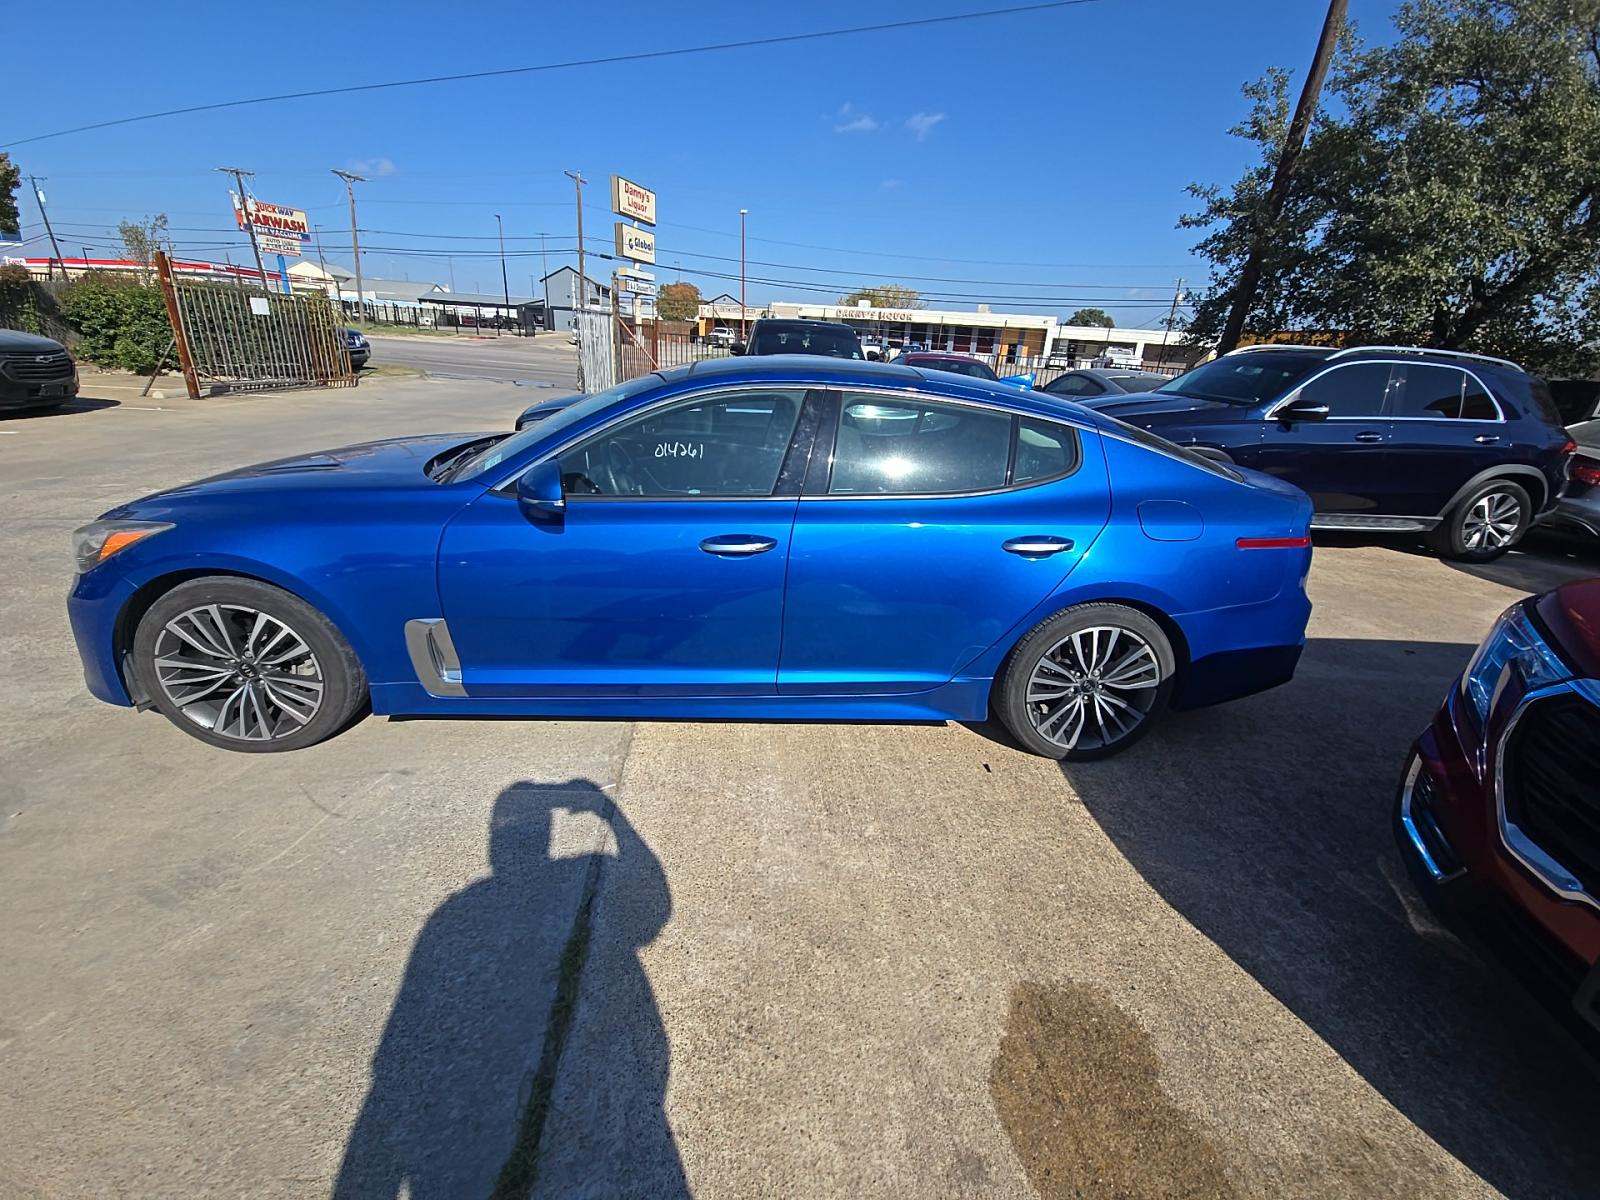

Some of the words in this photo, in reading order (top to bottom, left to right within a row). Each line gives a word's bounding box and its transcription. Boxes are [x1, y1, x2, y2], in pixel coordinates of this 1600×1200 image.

[624, 182, 650, 203] Danny's
[278, 206, 294, 217] WAY
[627, 195, 647, 213] Liquor
[634, 237, 653, 252] Global
[878, 311, 913, 321] LIQUOR
[654, 441, 704, 459] 014261
